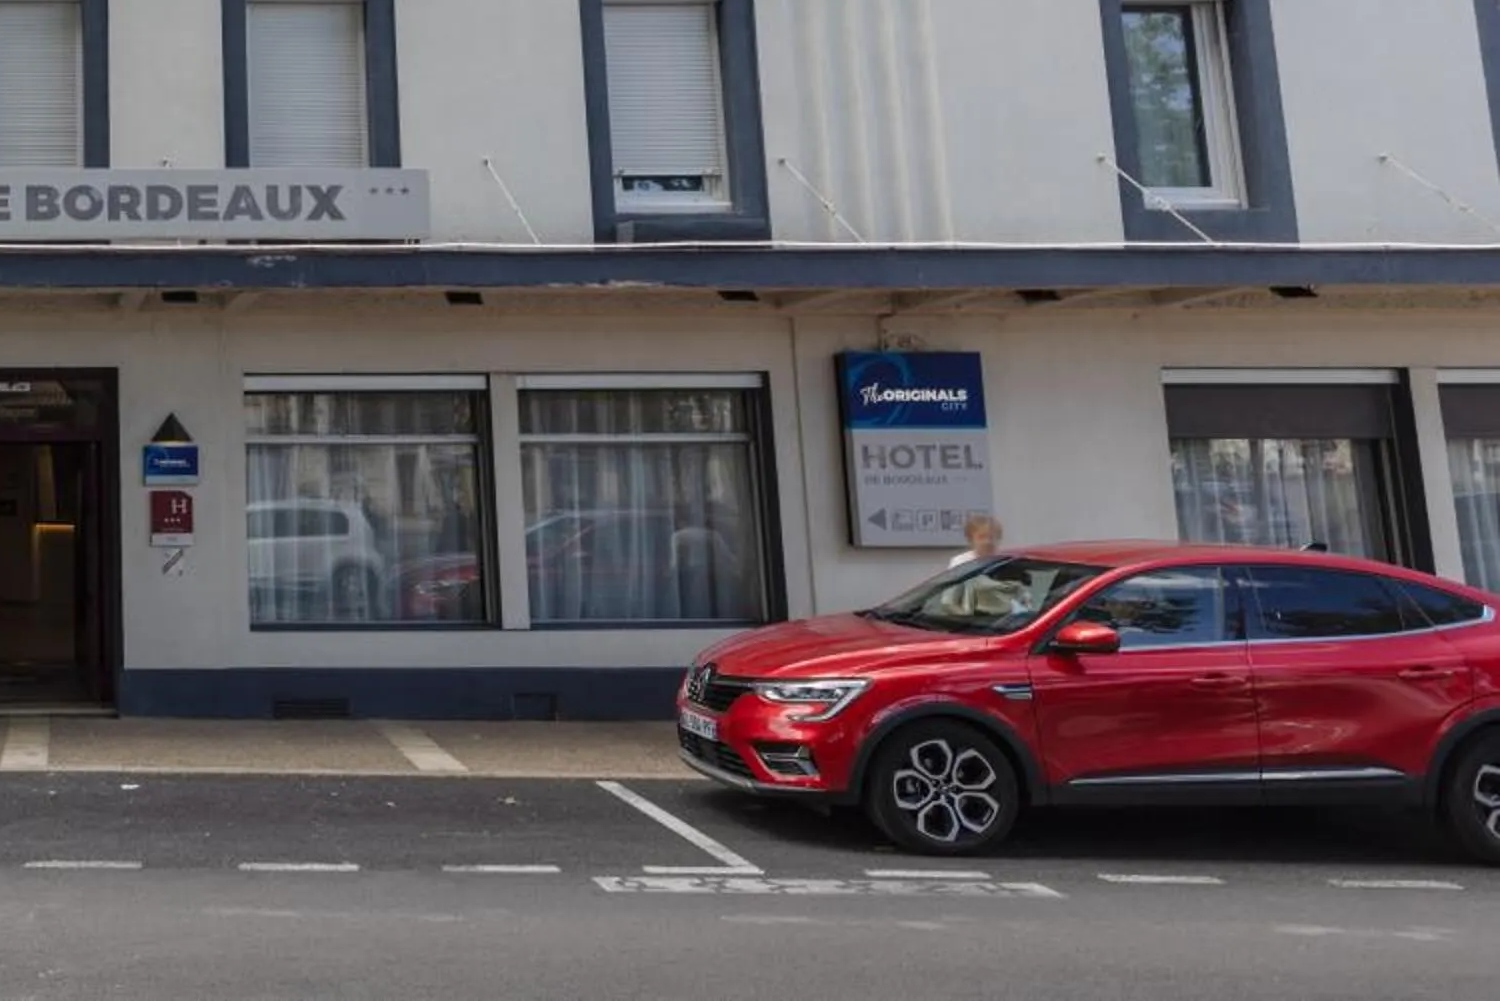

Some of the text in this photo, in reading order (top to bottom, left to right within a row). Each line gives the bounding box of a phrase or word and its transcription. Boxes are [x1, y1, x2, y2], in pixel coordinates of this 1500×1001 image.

[25, 185, 347, 221] BORDEAUX
[941, 402, 968, 411] CITY
[861, 445, 983, 469] HOTEL
[171, 498, 187, 514] H
